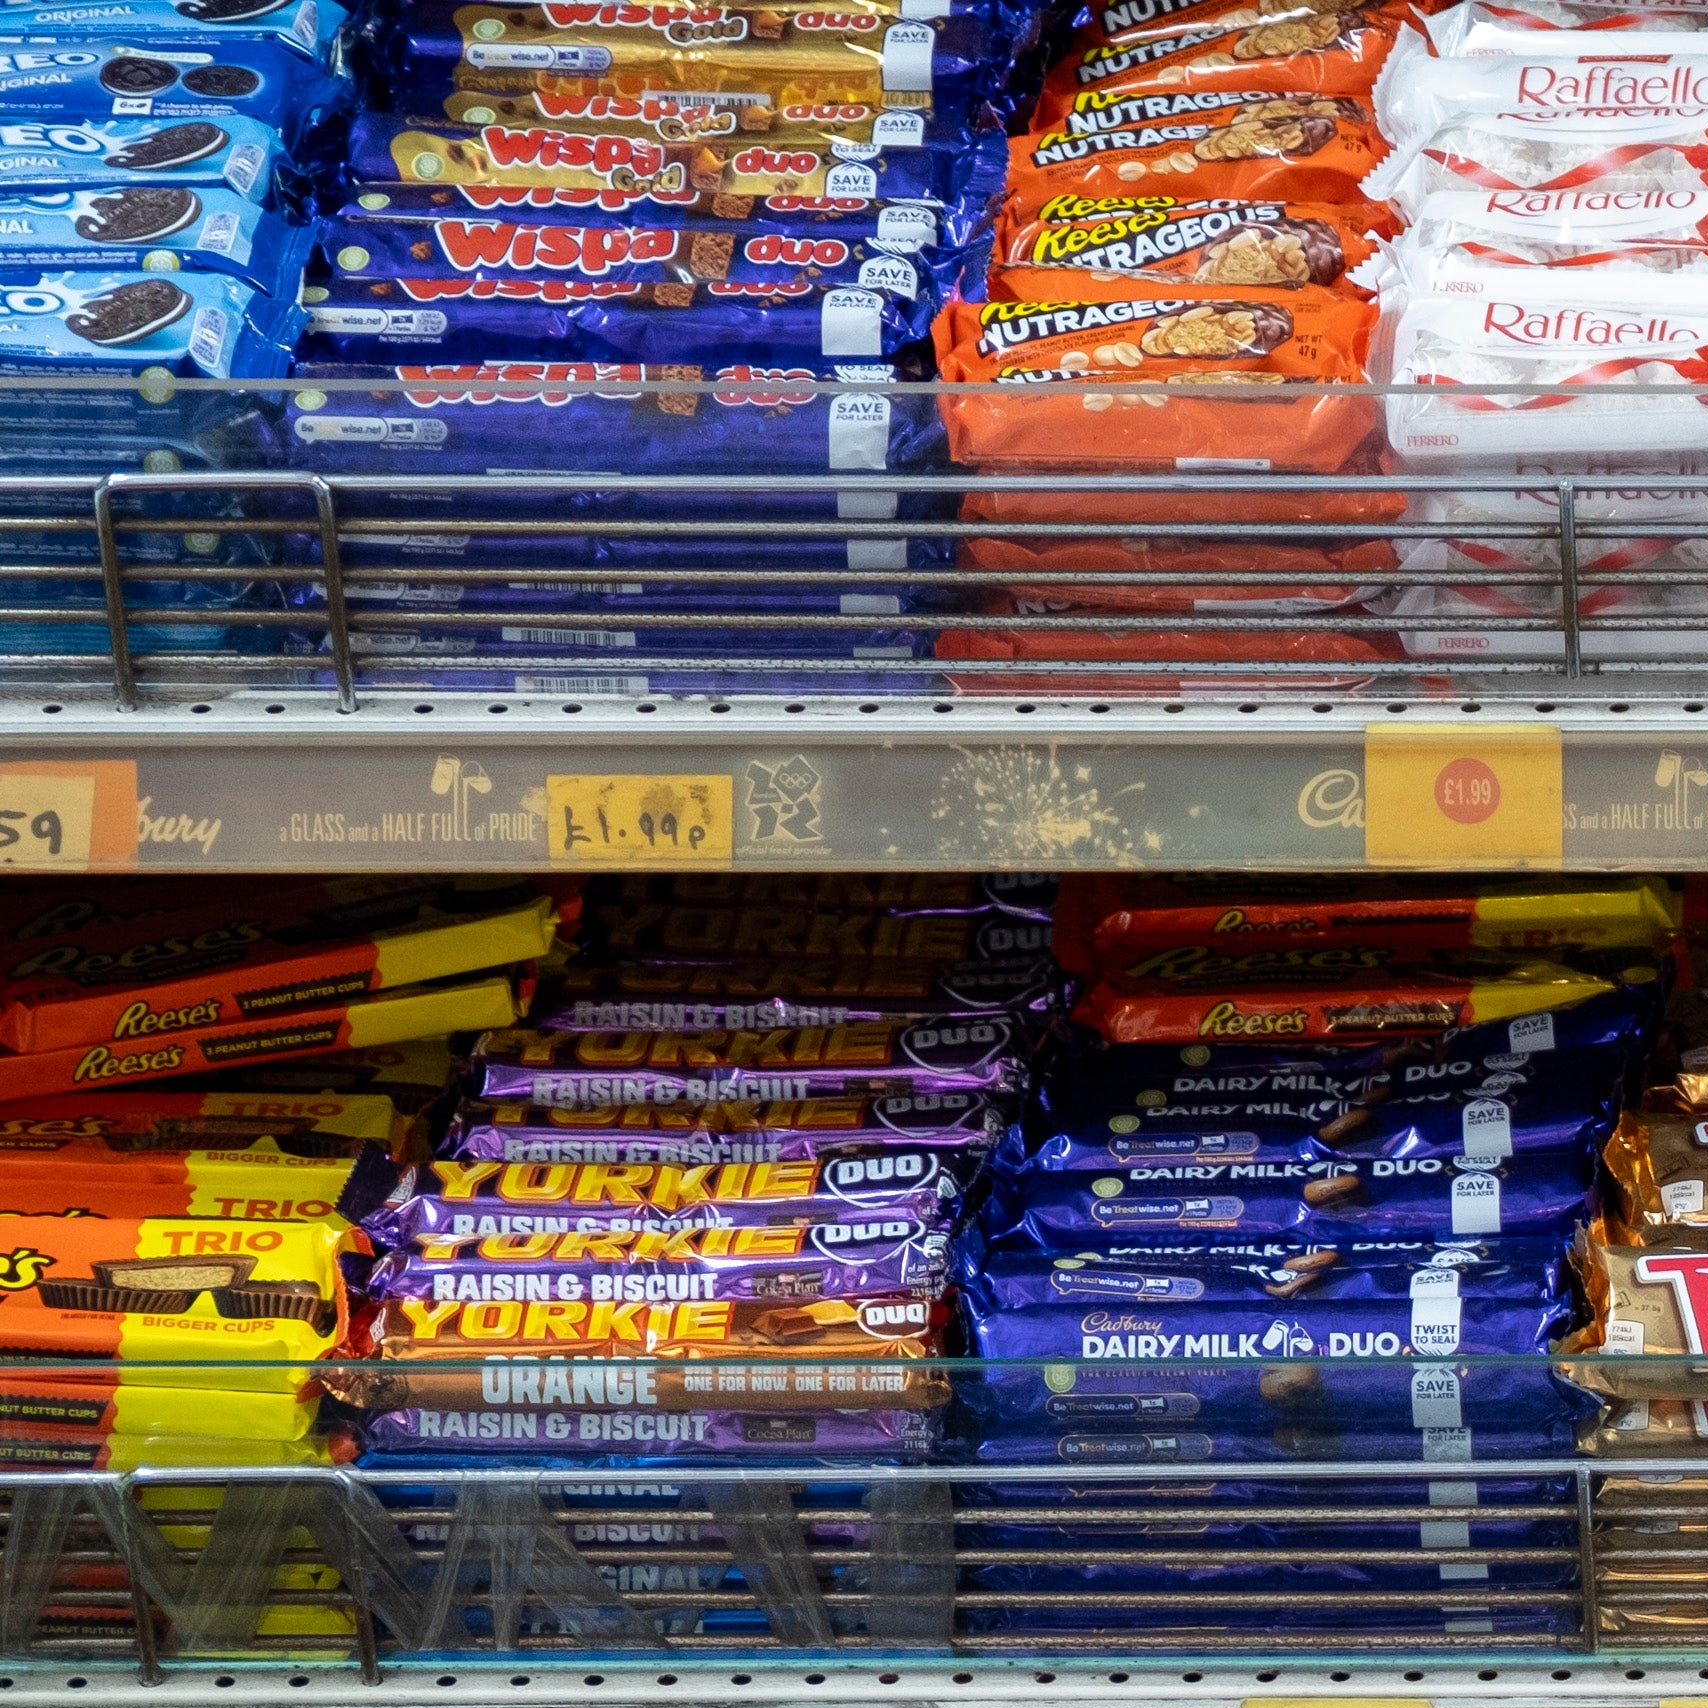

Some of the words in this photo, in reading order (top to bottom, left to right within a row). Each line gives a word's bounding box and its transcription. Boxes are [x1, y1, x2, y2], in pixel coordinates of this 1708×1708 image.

[733, 146, 818, 176] duo
[435, 219, 681, 273] Wispa
[745, 234, 849, 266] duo
[835, 401, 884, 416] SAVE
[1444, 778, 1492, 807] £1.99
[290, 815, 345, 842] GLASS
[382, 814, 427, 842] HALF
[489, 815, 539, 842] PRIDE
[162, 1230, 283, 1254] TRIO
[434, 1274, 548, 1301] RAISIN
[555, 1275, 585, 1300] &
[593, 1273, 717, 1301] BISCUIT
[143, 1314, 217, 1333] BIGGER
[222, 1318, 275, 1333] CUPS
[401, 1299, 735, 1344] YORKIE
[1081, 1312, 1162, 1336] Cadbury
[1082, 1334, 1178, 1358] DAIRY
[1184, 1334, 1261, 1357] MILK
[1331, 1332, 1400, 1357] DUO
